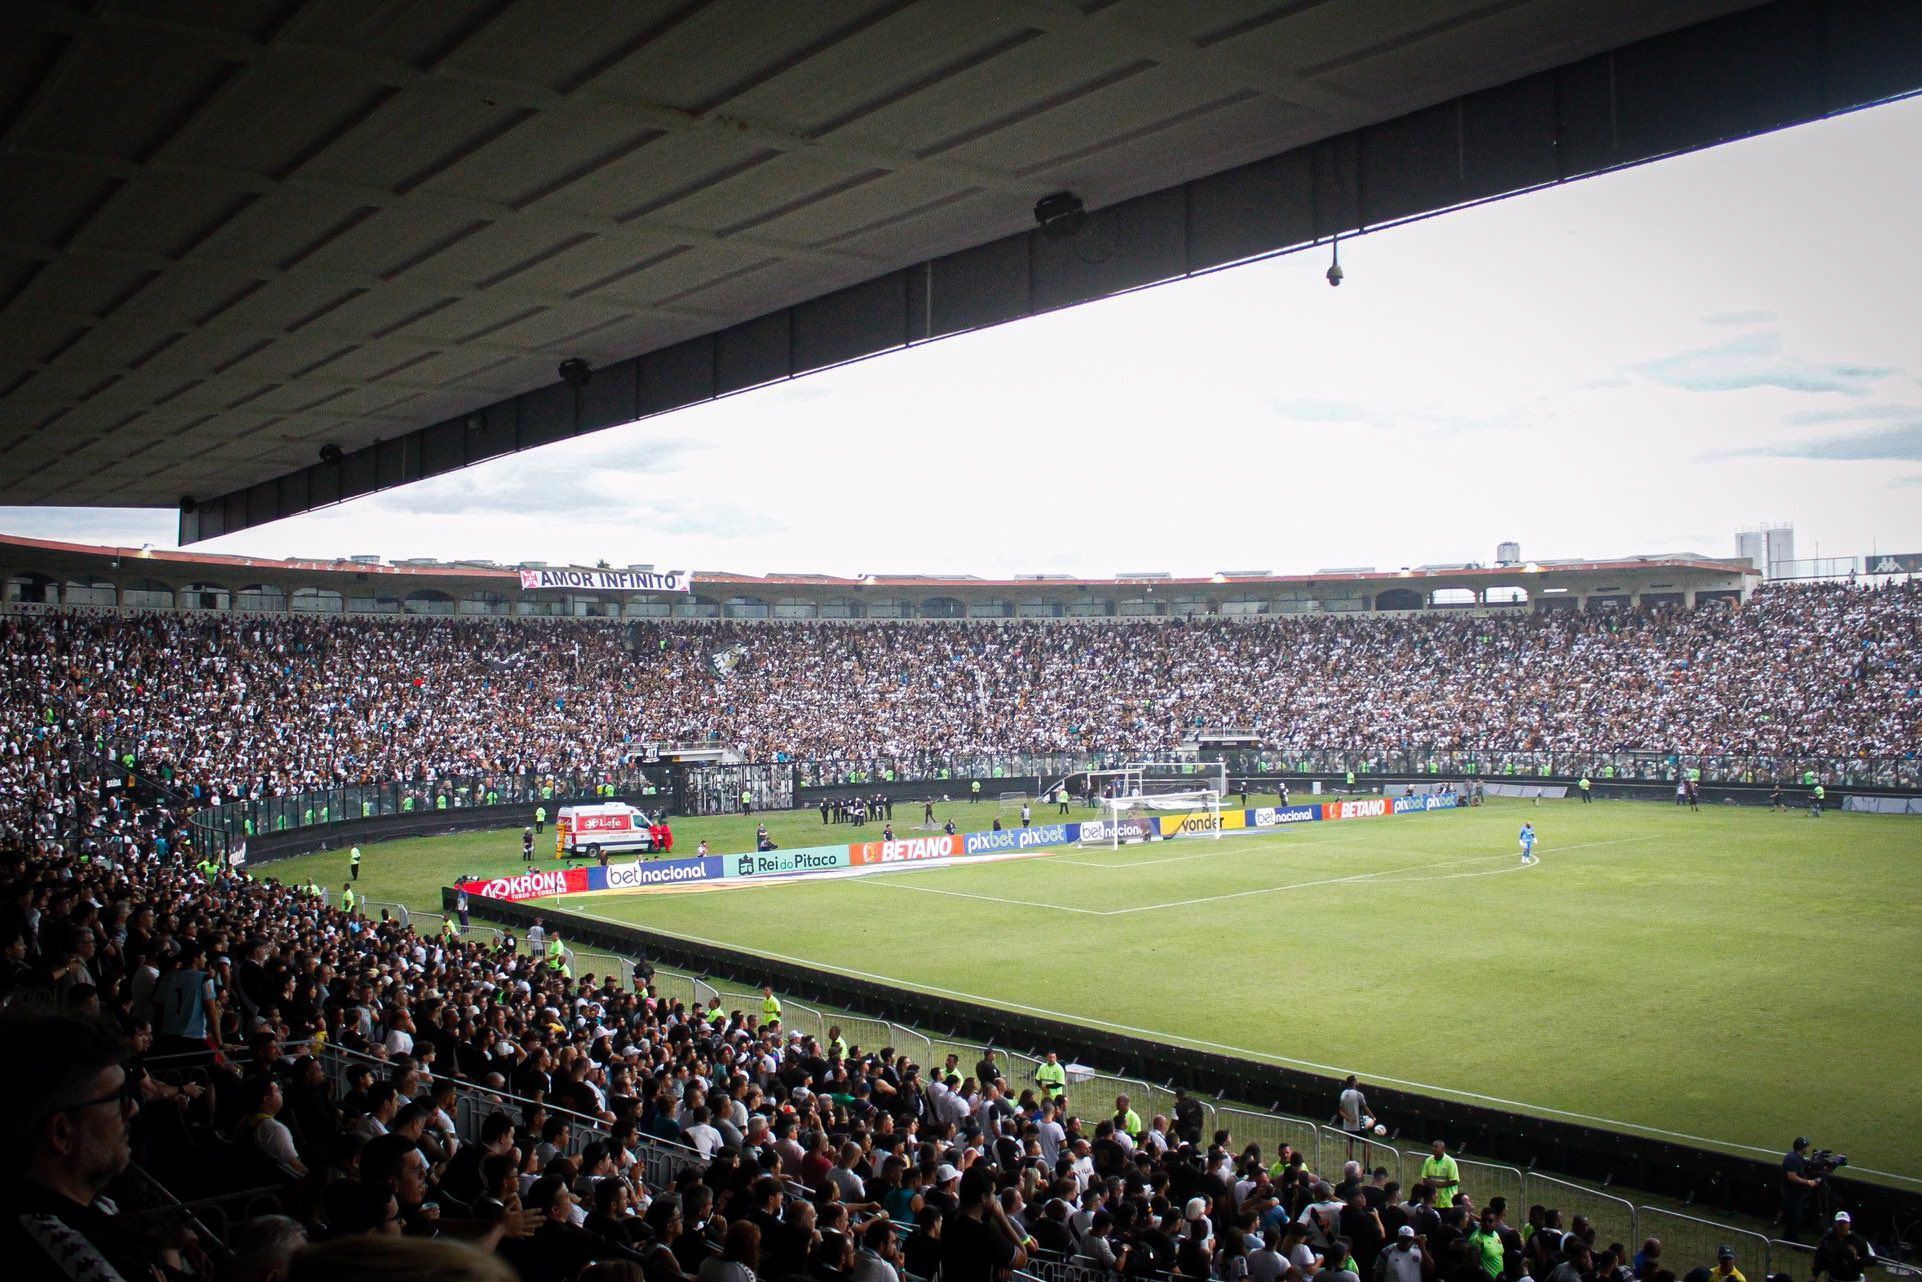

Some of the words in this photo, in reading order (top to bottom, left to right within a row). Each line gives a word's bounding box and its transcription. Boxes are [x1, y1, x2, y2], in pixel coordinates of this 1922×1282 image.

[541, 571, 595, 587] AMOR
[600, 573, 676, 589] INFINITO
[1341, 800, 1385, 818] BETANO
[882, 837, 952, 862] BETANO
[968, 831, 1014, 854] pixbet
[1020, 825, 1064, 848] pixbet
[758, 856, 779, 872] Rei
[780, 859, 793, 870] do
[794, 854, 837, 868] Pitaco
[510, 871, 567, 894] KRONA
